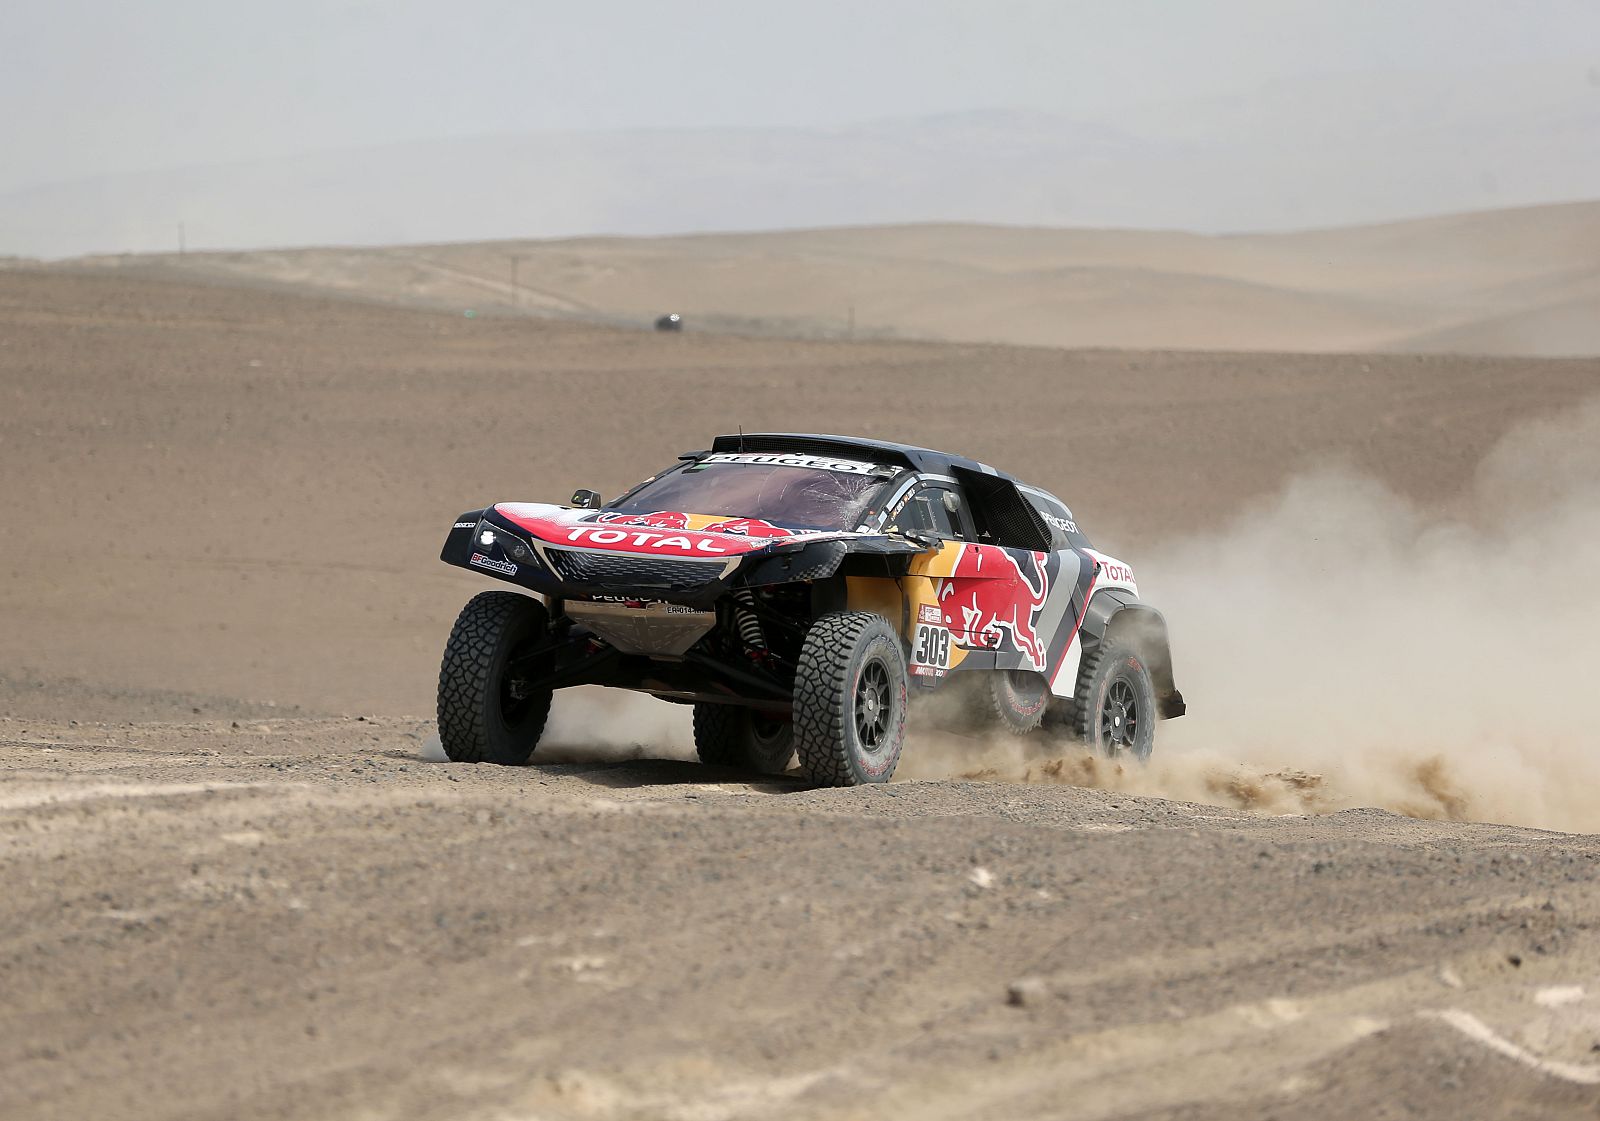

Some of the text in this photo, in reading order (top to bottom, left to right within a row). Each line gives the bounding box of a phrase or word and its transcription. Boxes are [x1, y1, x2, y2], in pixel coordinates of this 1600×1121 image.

[1040, 511, 1080, 535] PEUGEOT
[566, 526, 726, 553] TOTAL
[471, 553, 517, 574] BFGoodrich
[916, 626, 950, 667] 303
